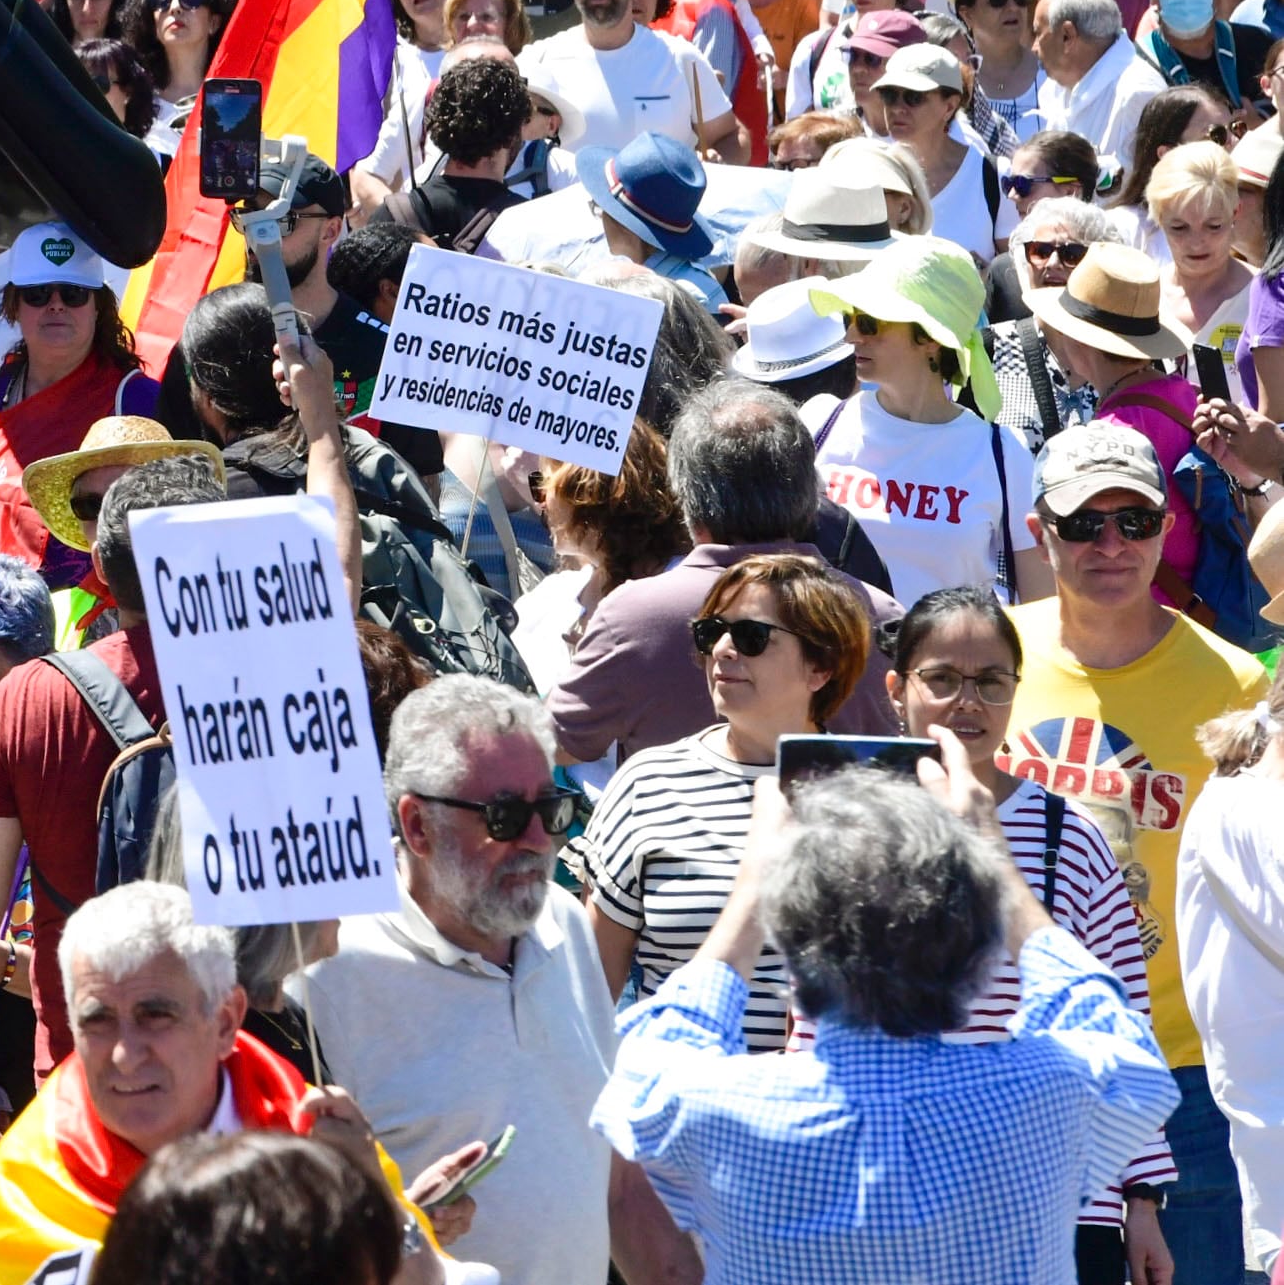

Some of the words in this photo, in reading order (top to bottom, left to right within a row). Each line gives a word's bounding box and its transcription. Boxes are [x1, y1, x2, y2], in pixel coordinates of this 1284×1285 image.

[403, 281, 492, 326] Ratios
[497, 310, 557, 344] más
[558, 320, 648, 369] justas
[379, 372, 397, 403] y
[397, 375, 505, 418] residencias
[506, 395, 533, 426] de
[534, 408, 621, 453] mayores.
[393, 330, 424, 358] en
[427, 337, 534, 381] servicios
[536, 364, 636, 411] sociales
[1066, 441, 1135, 462] NYPD
[825, 469, 971, 526] HONEY
[153, 555, 220, 639] Con
[216, 553, 251, 631] tu
[254, 537, 334, 627] salud
[176, 675, 275, 767] harán
[283, 667, 359, 774] caja
[202, 832, 223, 896] o
[229, 812, 266, 893] tu
[270, 794, 382, 890] ataúd.
